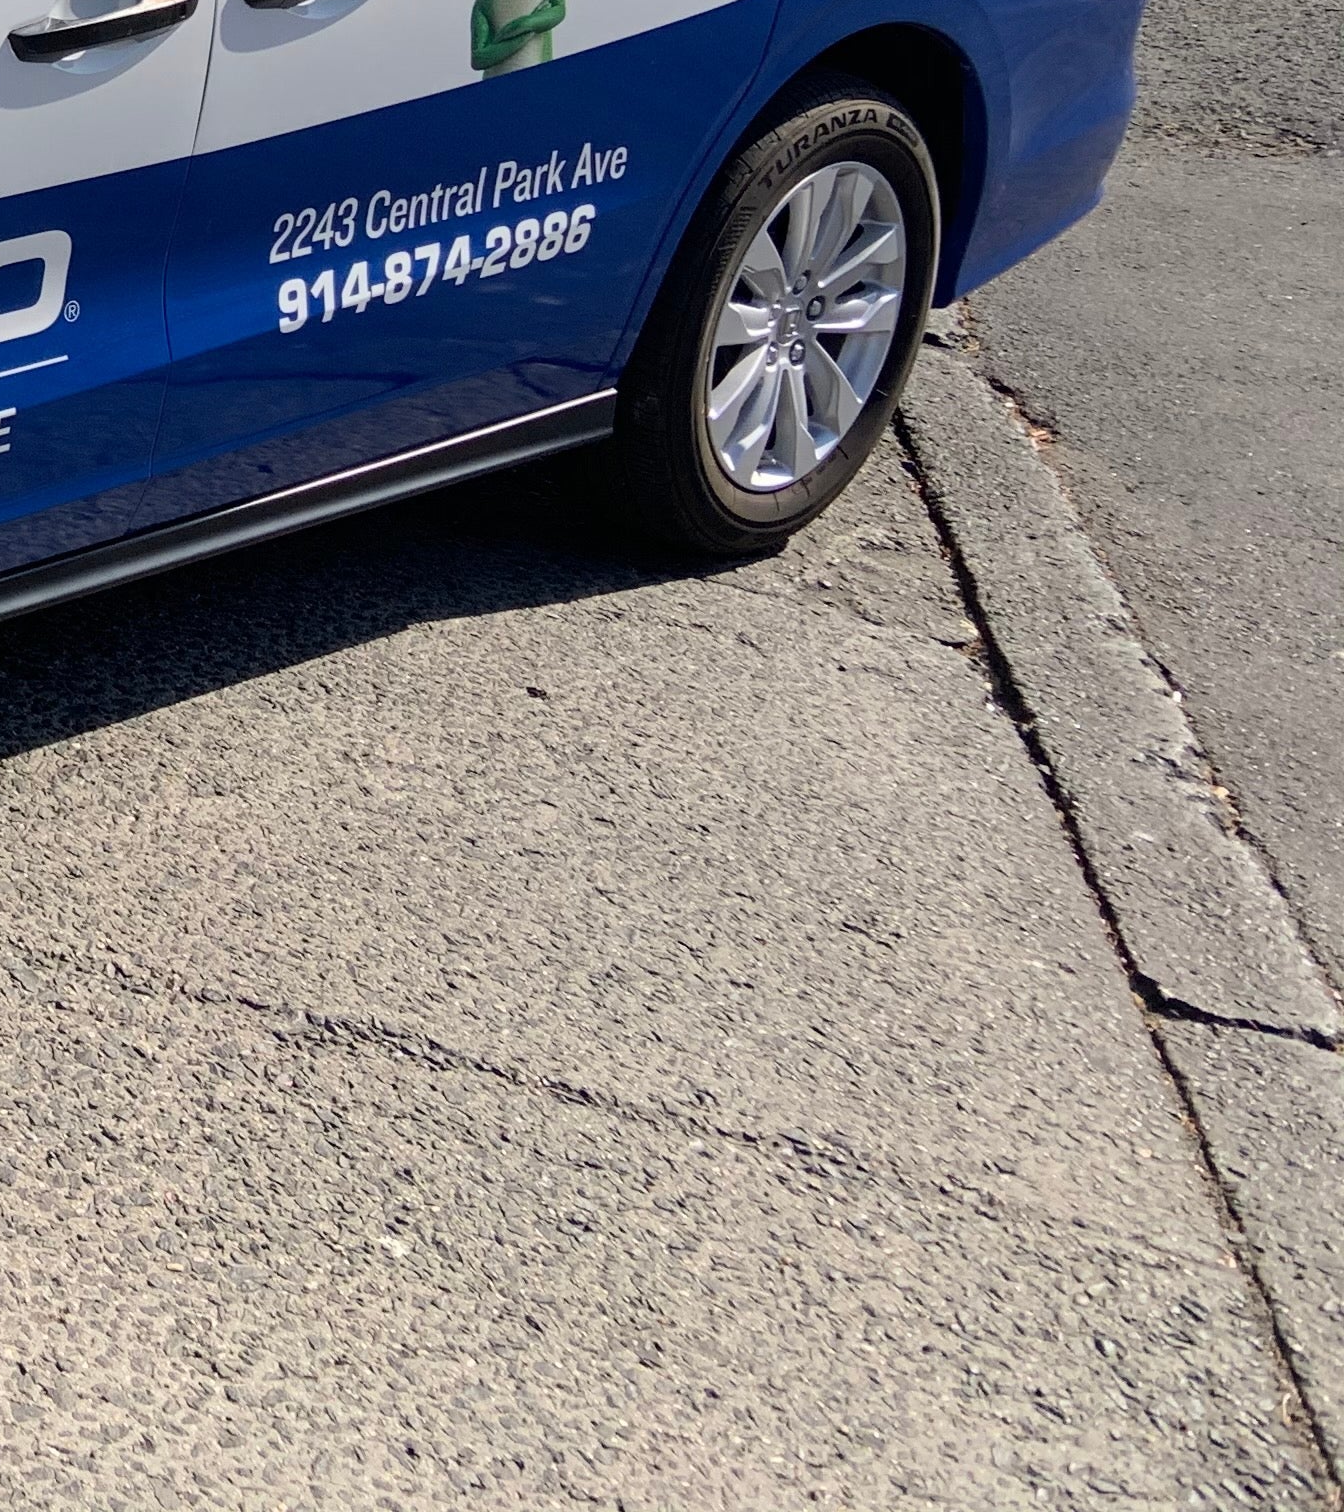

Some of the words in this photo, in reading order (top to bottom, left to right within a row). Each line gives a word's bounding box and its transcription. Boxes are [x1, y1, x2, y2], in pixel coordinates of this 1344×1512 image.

[269, 197, 358, 264] 2243
[366, 167, 486, 240] Central
[493, 150, 564, 209] Park
[571, 142, 628, 189] Ave
[757, 108, 878, 189] TURANZA
[278, 204, 596, 334] 914-874-2886
